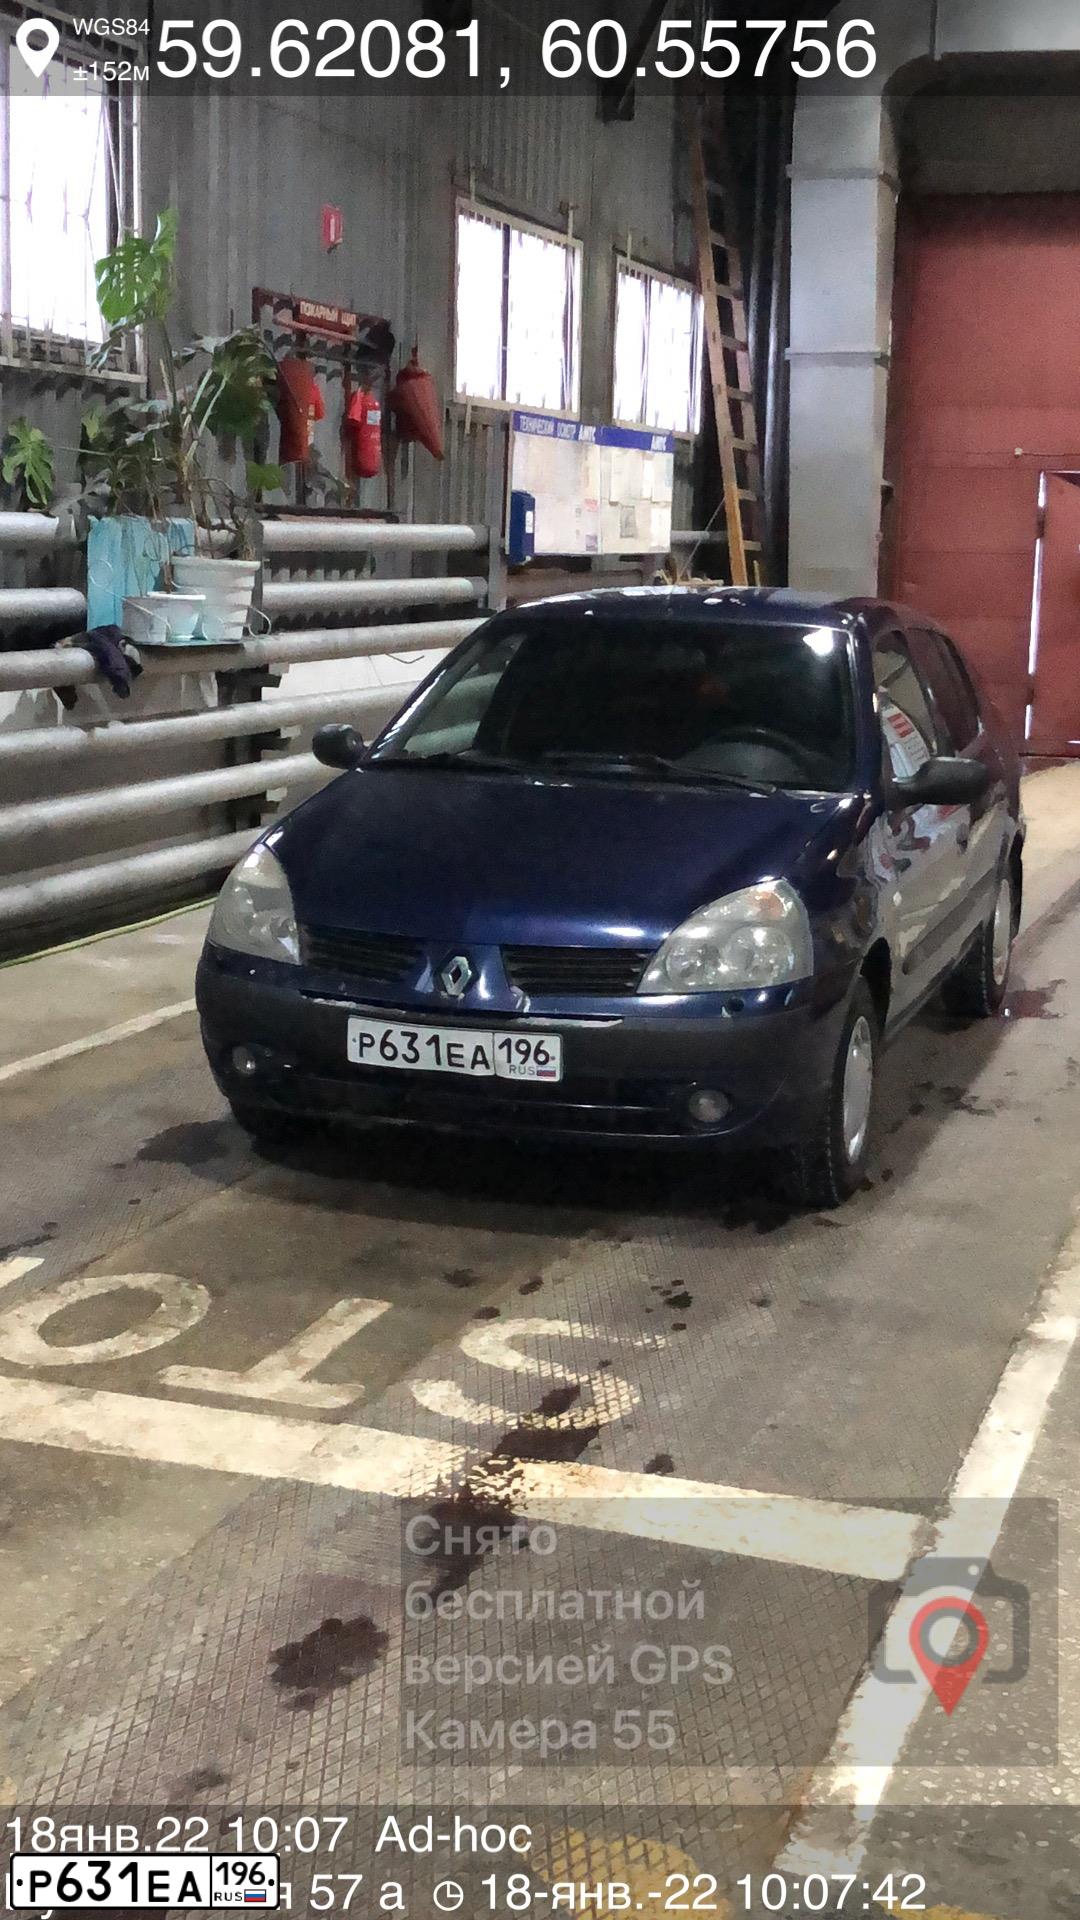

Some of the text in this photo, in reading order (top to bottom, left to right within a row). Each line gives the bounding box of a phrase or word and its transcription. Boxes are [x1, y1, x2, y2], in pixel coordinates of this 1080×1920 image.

[358, 1028, 550, 1070] Р631ЕА 196
[508, 1063, 535, 1076] RUS
[0, 1256, 662, 1431] STO
